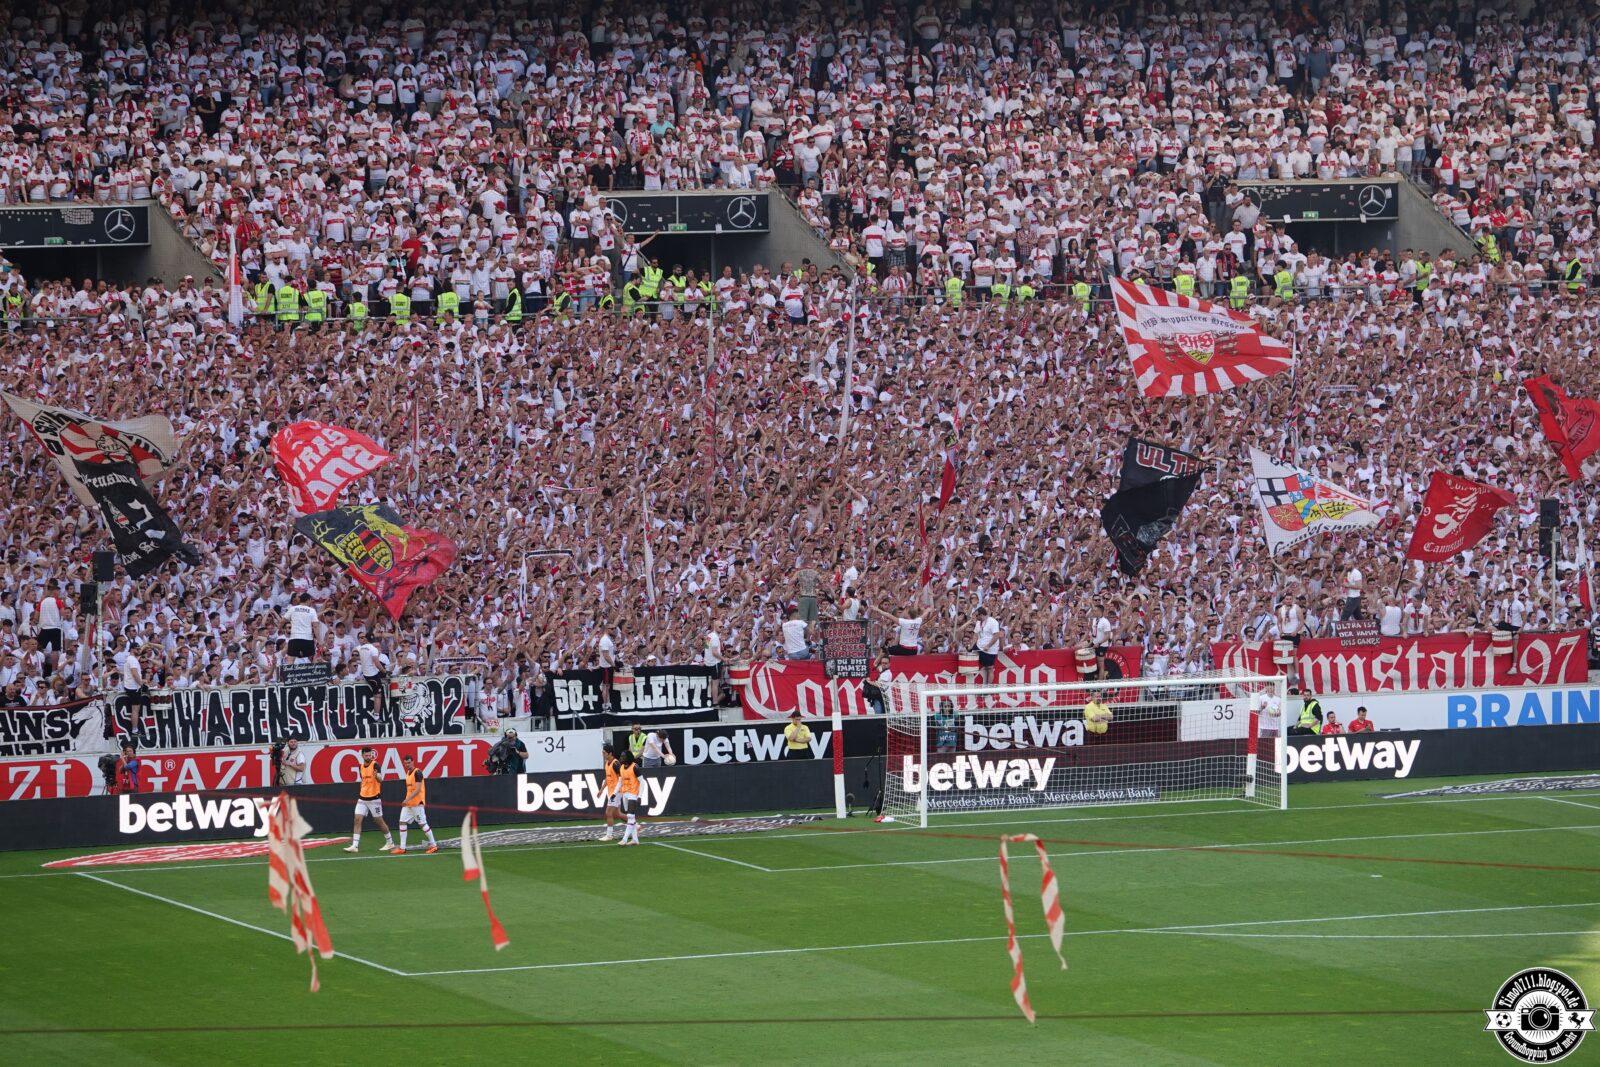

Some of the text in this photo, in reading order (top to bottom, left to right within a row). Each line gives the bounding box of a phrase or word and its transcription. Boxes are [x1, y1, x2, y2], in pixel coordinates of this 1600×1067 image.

[1136, 442, 1200, 477] ULTR
[1336, 622, 1362, 630] ULTRA
[1519, 634, 1581, 687] 97
[553, 679, 600, 711] 50+
[1213, 704, 1234, 720] 35
[683, 728, 832, 765] betwy
[964, 716, 1087, 751] betwa
[903, 754, 1056, 792] betway
[1274, 736, 1421, 778] betway
[517, 773, 677, 816] betwy
[928, 786, 1156, 809] Mercedes-Benz Bank Mercedes-Benz Bank
[119, 794, 280, 837] betway
